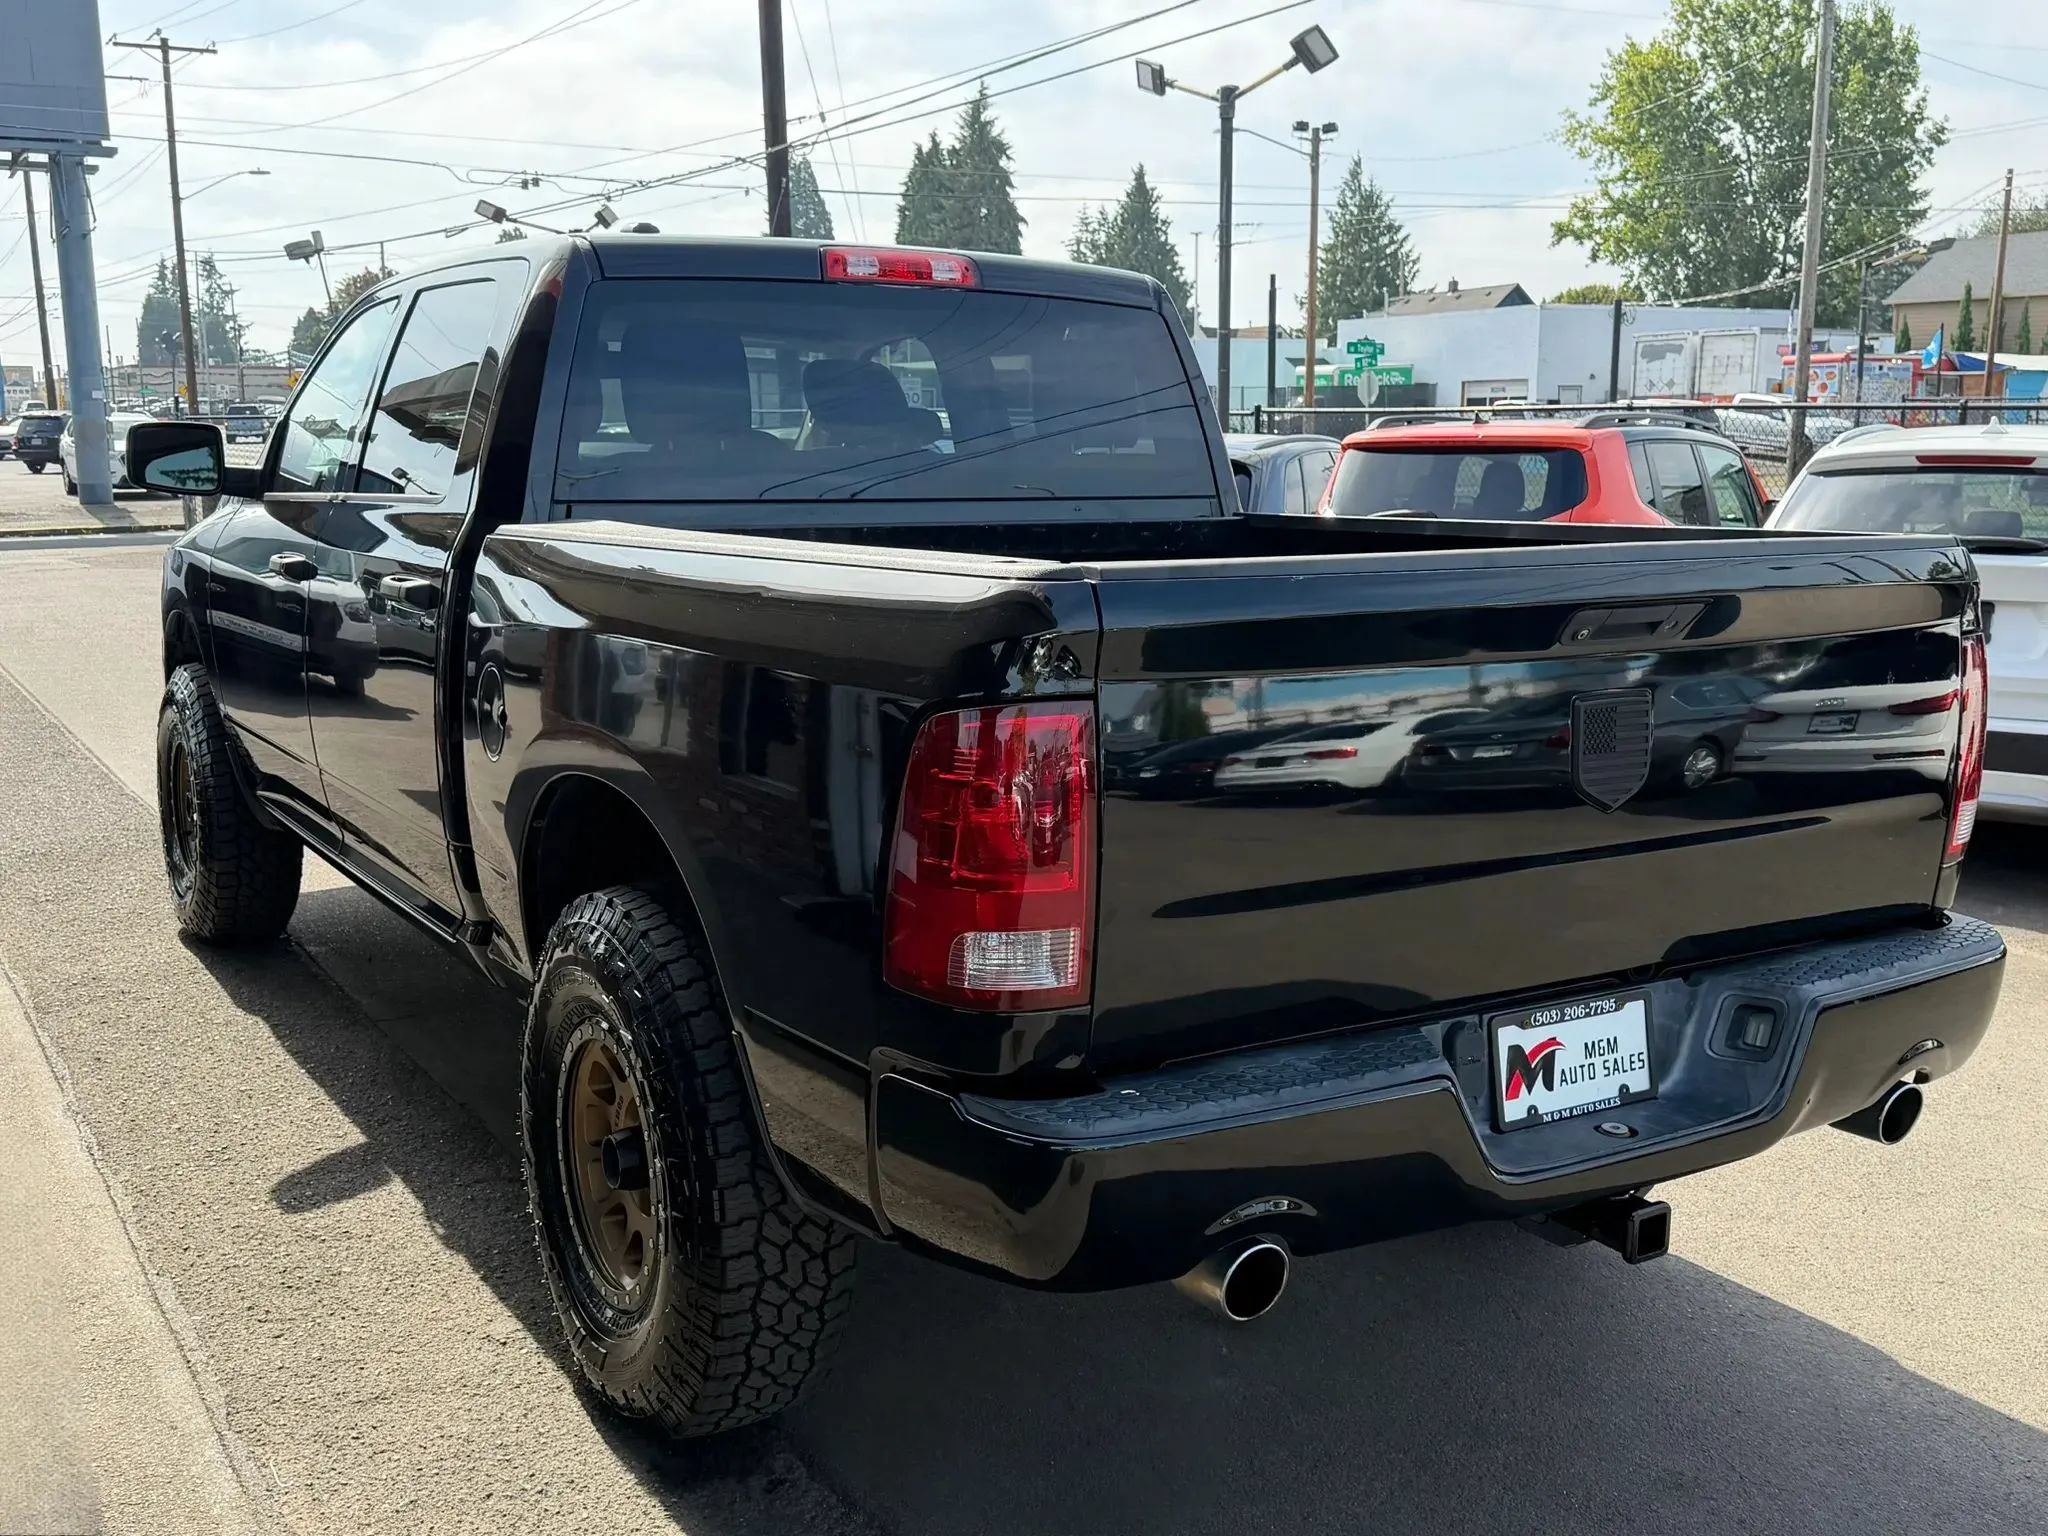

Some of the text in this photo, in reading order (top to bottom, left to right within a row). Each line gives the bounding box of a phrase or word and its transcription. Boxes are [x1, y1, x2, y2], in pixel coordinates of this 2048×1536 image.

[1531, 998, 1616, 1025] (503) 206-7795
[1584, 1036, 1619, 1060] M&M
[1560, 1051, 1645, 1087] AUTO SALES
[1542, 1097, 1621, 1122] M & M AUTO SALES
